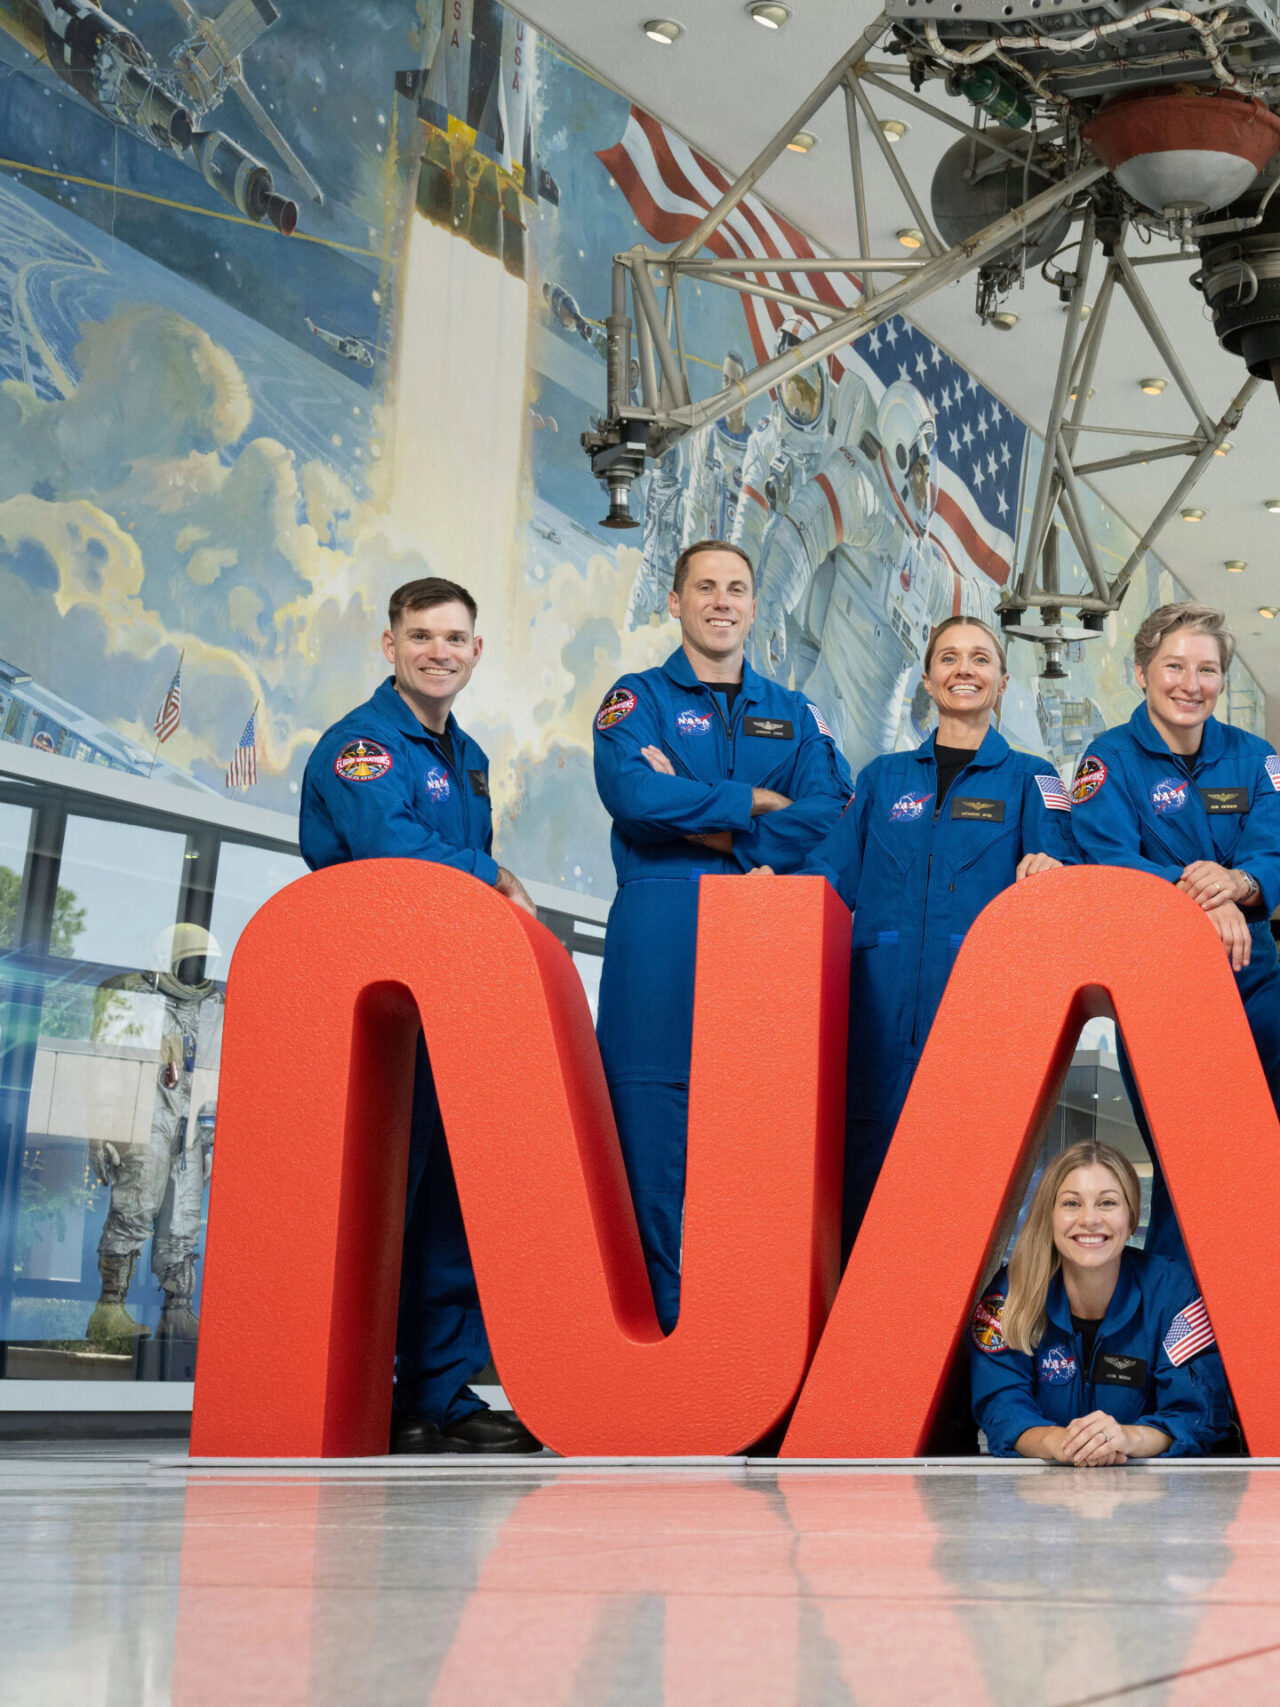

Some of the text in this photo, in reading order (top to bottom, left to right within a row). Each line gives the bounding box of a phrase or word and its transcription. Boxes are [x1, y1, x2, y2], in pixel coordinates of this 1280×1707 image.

[512, 22, 524, 94] USA
[678, 716, 710, 726] NASA
[336, 758, 355, 770] FLIGHT
[356, 755, 390, 766] OPERATIONS
[426, 779, 450, 790] NASA
[1153, 790, 1186, 802] NASA
[893, 801, 922, 811] NASA
[1042, 1358, 1077, 1370] NASA
